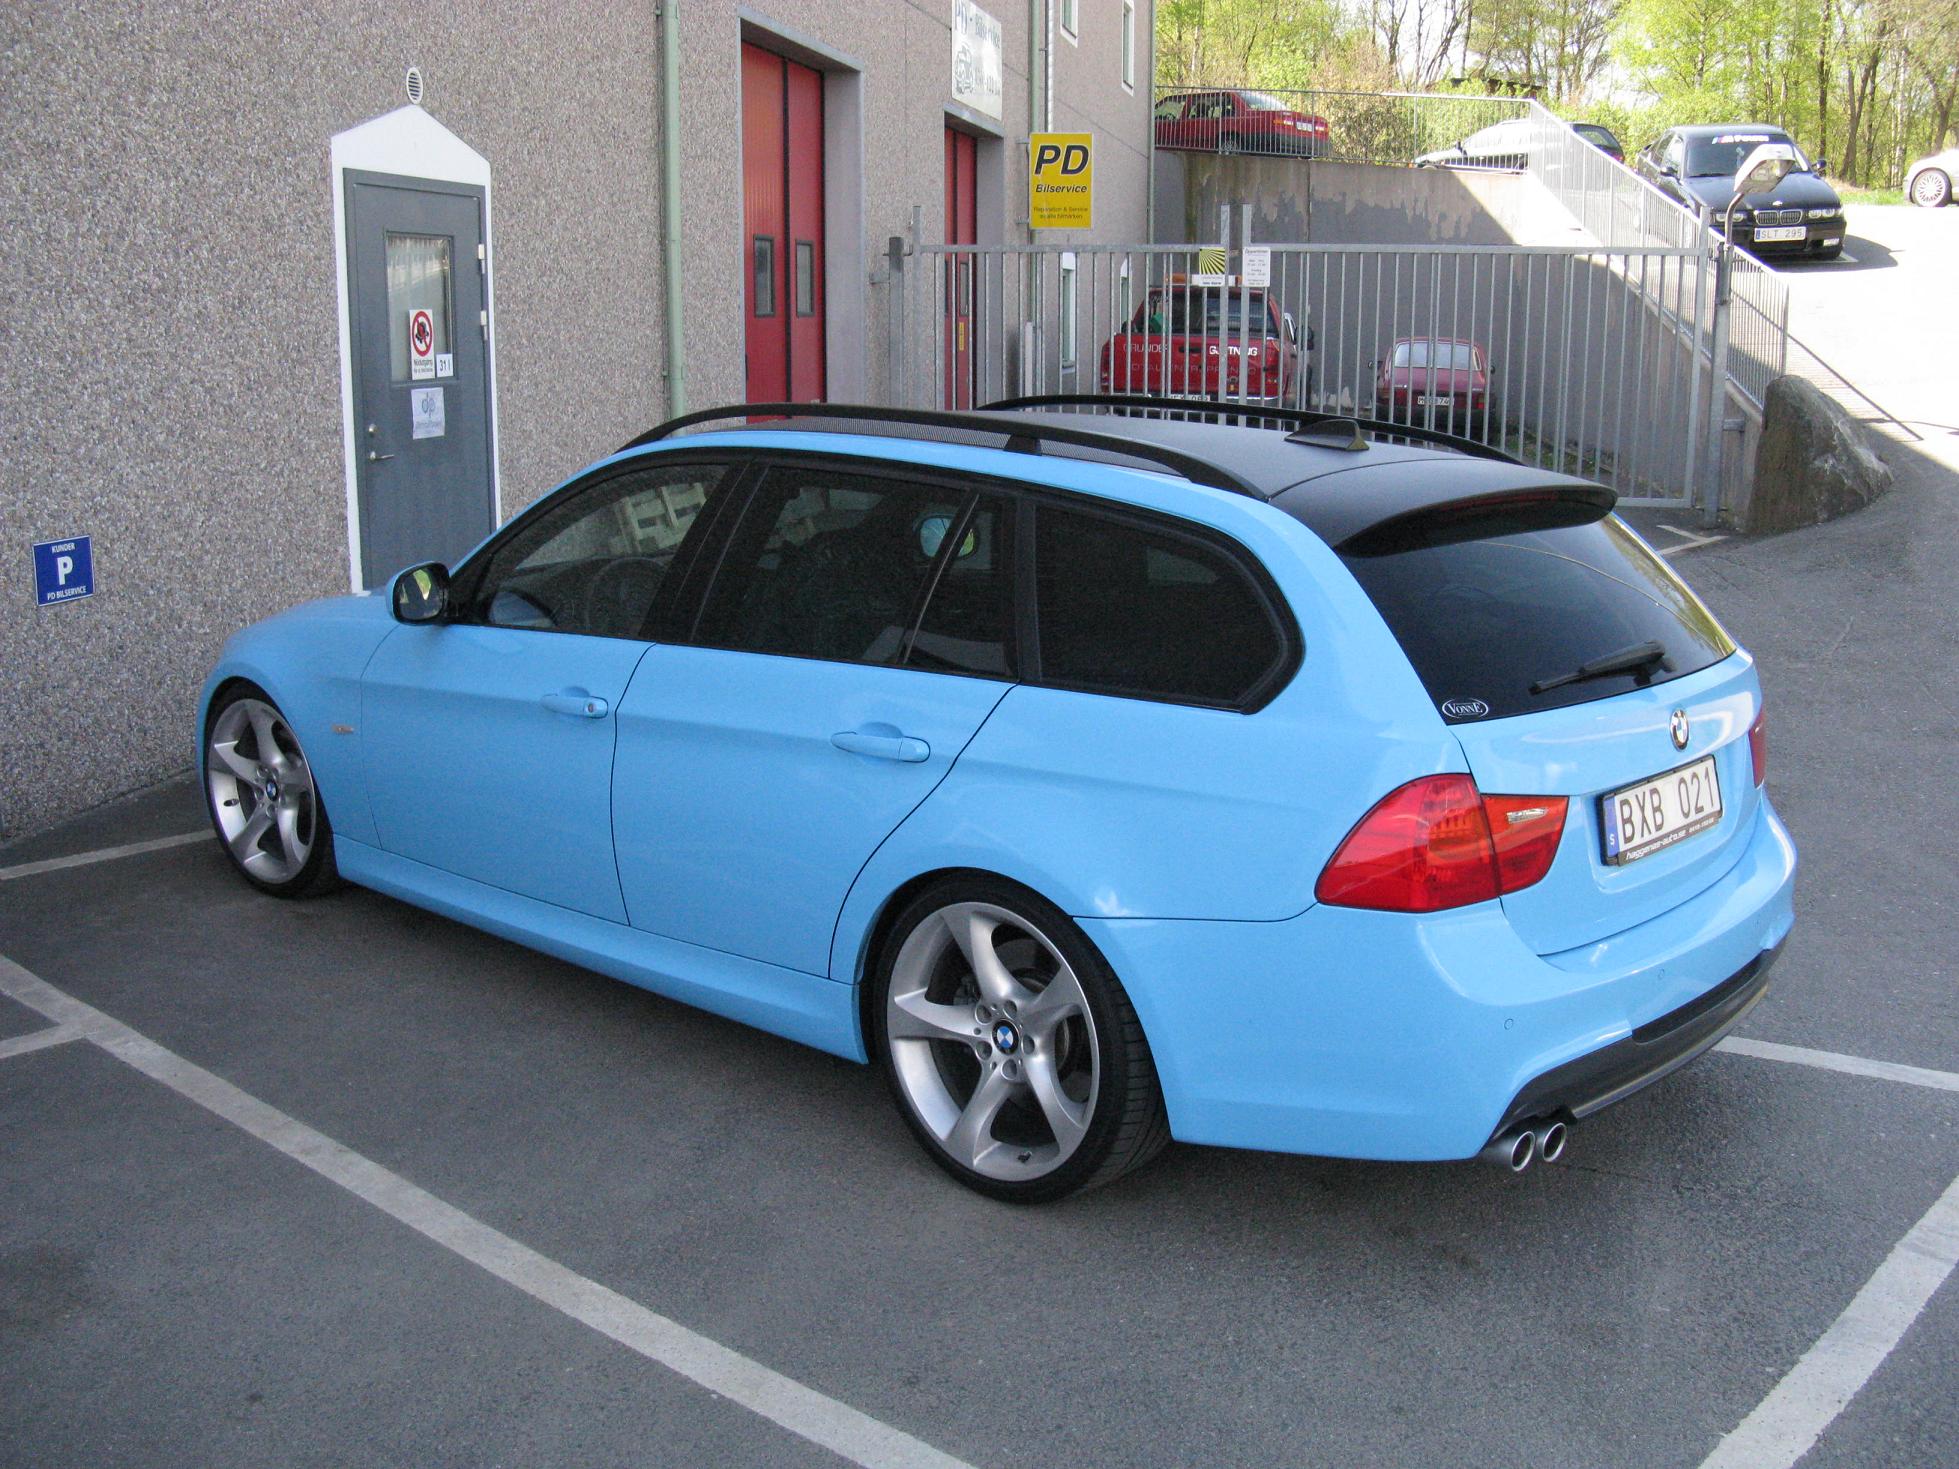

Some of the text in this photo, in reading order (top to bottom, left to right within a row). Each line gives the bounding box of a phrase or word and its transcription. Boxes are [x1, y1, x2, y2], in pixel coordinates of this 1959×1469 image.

[1033, 144, 1090, 176] PD
[1035, 184, 1088, 193] Bilservice
[1761, 228, 1802, 239] SLT 295
[51, 542, 76, 554] KUNDER
[56, 555, 74, 585] P
[47, 585, 87, 601] PD BILSERVICE
[1619, 766, 1714, 844] BXB 021
[1609, 833, 1615, 846] S
